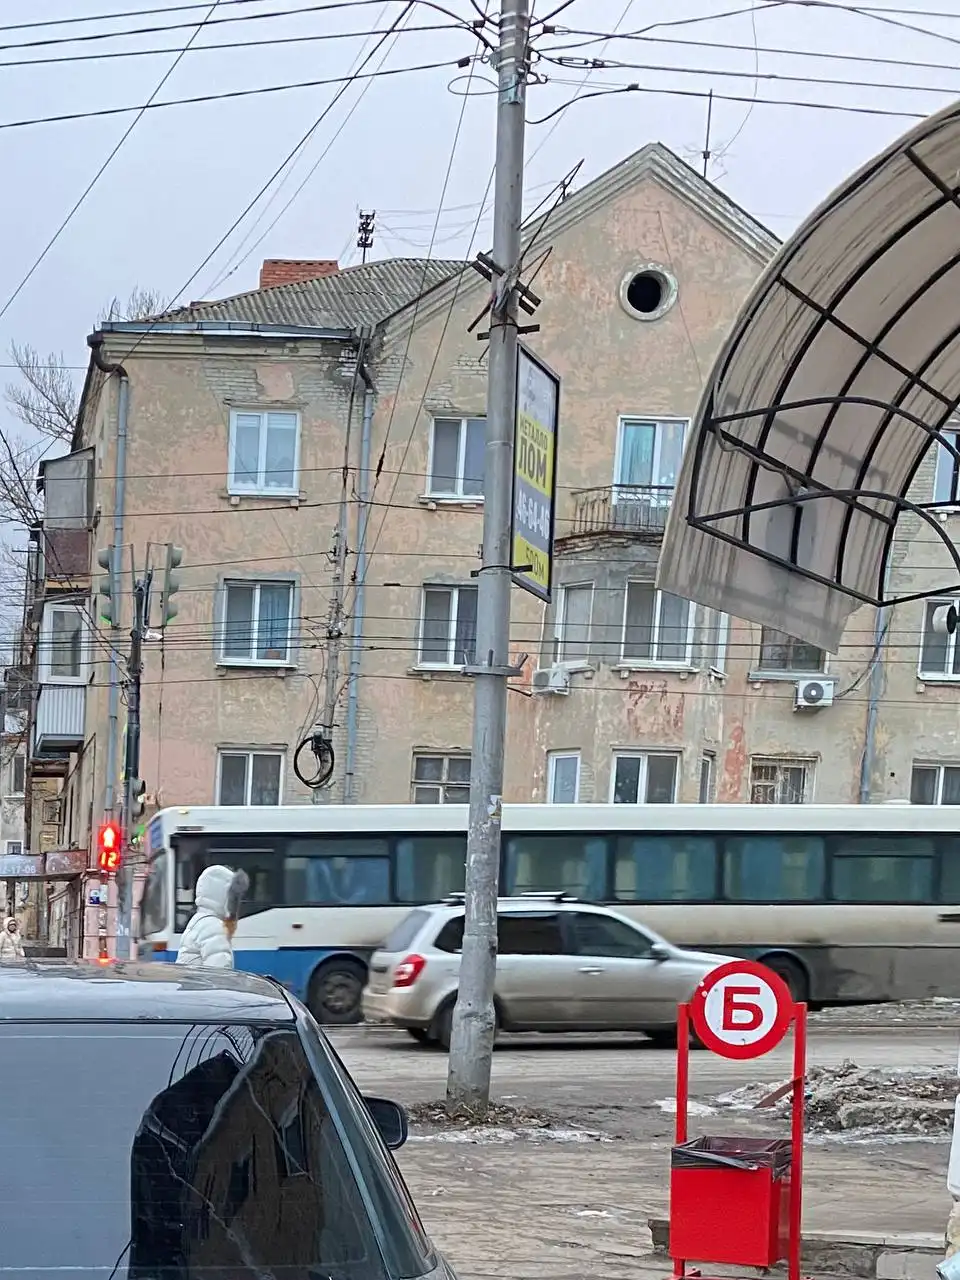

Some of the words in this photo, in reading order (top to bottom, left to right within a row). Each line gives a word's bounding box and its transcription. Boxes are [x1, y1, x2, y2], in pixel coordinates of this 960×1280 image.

[519, 436, 547, 489] ЛОМ
[100, 852, 116, 867] 12
[722, 987, 763, 1030] Б
